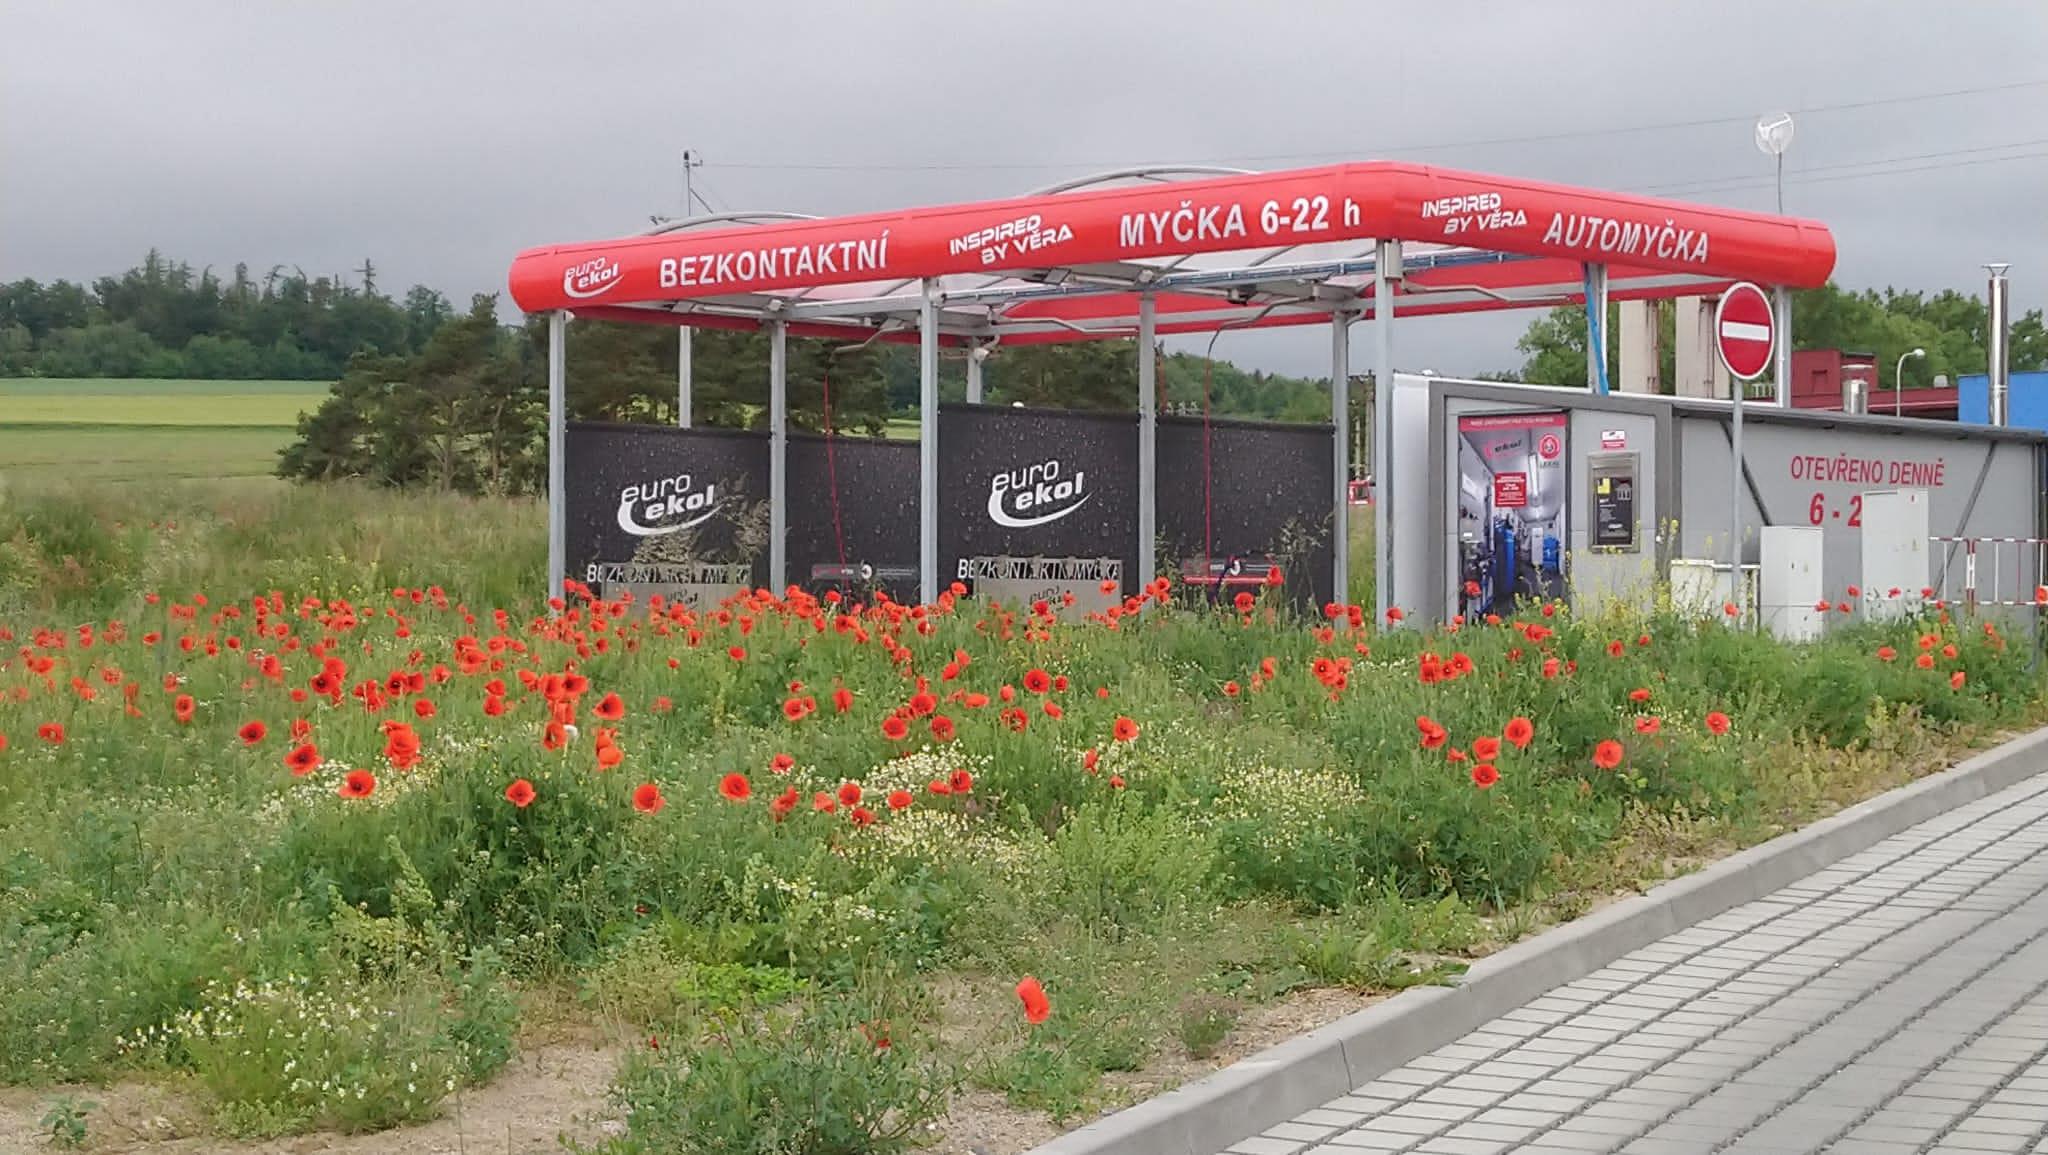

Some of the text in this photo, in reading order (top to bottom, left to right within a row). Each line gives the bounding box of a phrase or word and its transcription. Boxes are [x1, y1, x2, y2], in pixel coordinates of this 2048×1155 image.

[1120, 195, 1360, 247] MYČKA 6-22 h
[1422, 192, 1501, 218] INSPIRED
[1444, 206, 1528, 235] BY VĚRA
[950, 214, 1041, 255] INSPIRED
[980, 224, 1073, 265] BY VĚRA
[1543, 212, 1710, 263] AUTOMYČKA
[565, 257, 605, 277] euro
[578, 263, 618, 288] ekol
[659, 229, 890, 288] BEZKONTAKTNÍ
[992, 460, 1059, 492] euro
[1791, 452, 1945, 487] OTEVŘENO DENNĚ
[621, 474, 691, 504] euro
[645, 484, 715, 520] ekol
[1015, 472, 1084, 510] ekol
[1810, 493, 1825, 526] 6
